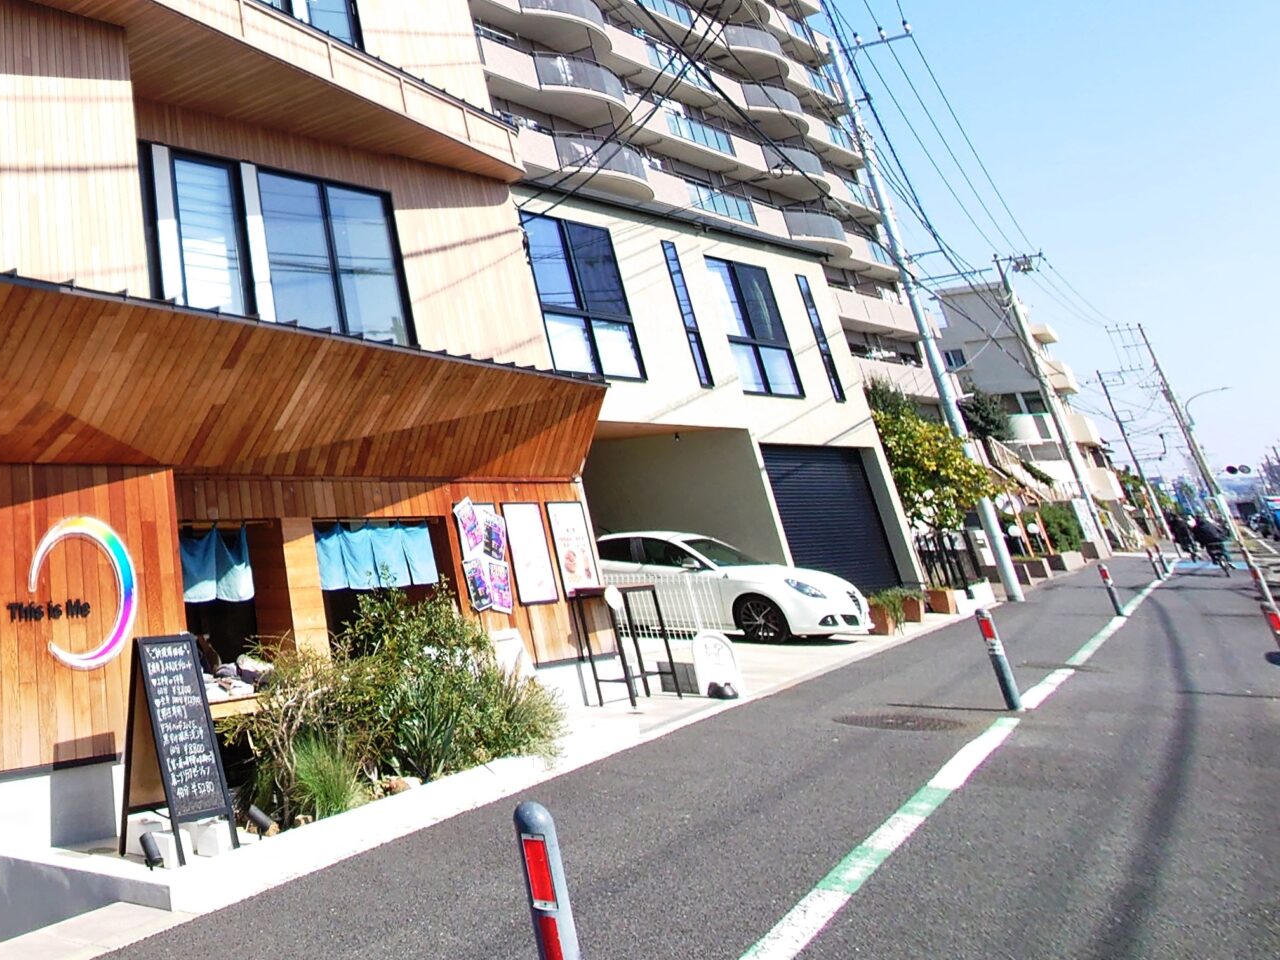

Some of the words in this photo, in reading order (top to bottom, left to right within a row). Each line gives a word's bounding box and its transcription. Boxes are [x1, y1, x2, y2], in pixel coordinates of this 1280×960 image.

[7, 601, 45, 623] This
[47, 601, 62, 620] is
[66, 599, 91, 619] Me
